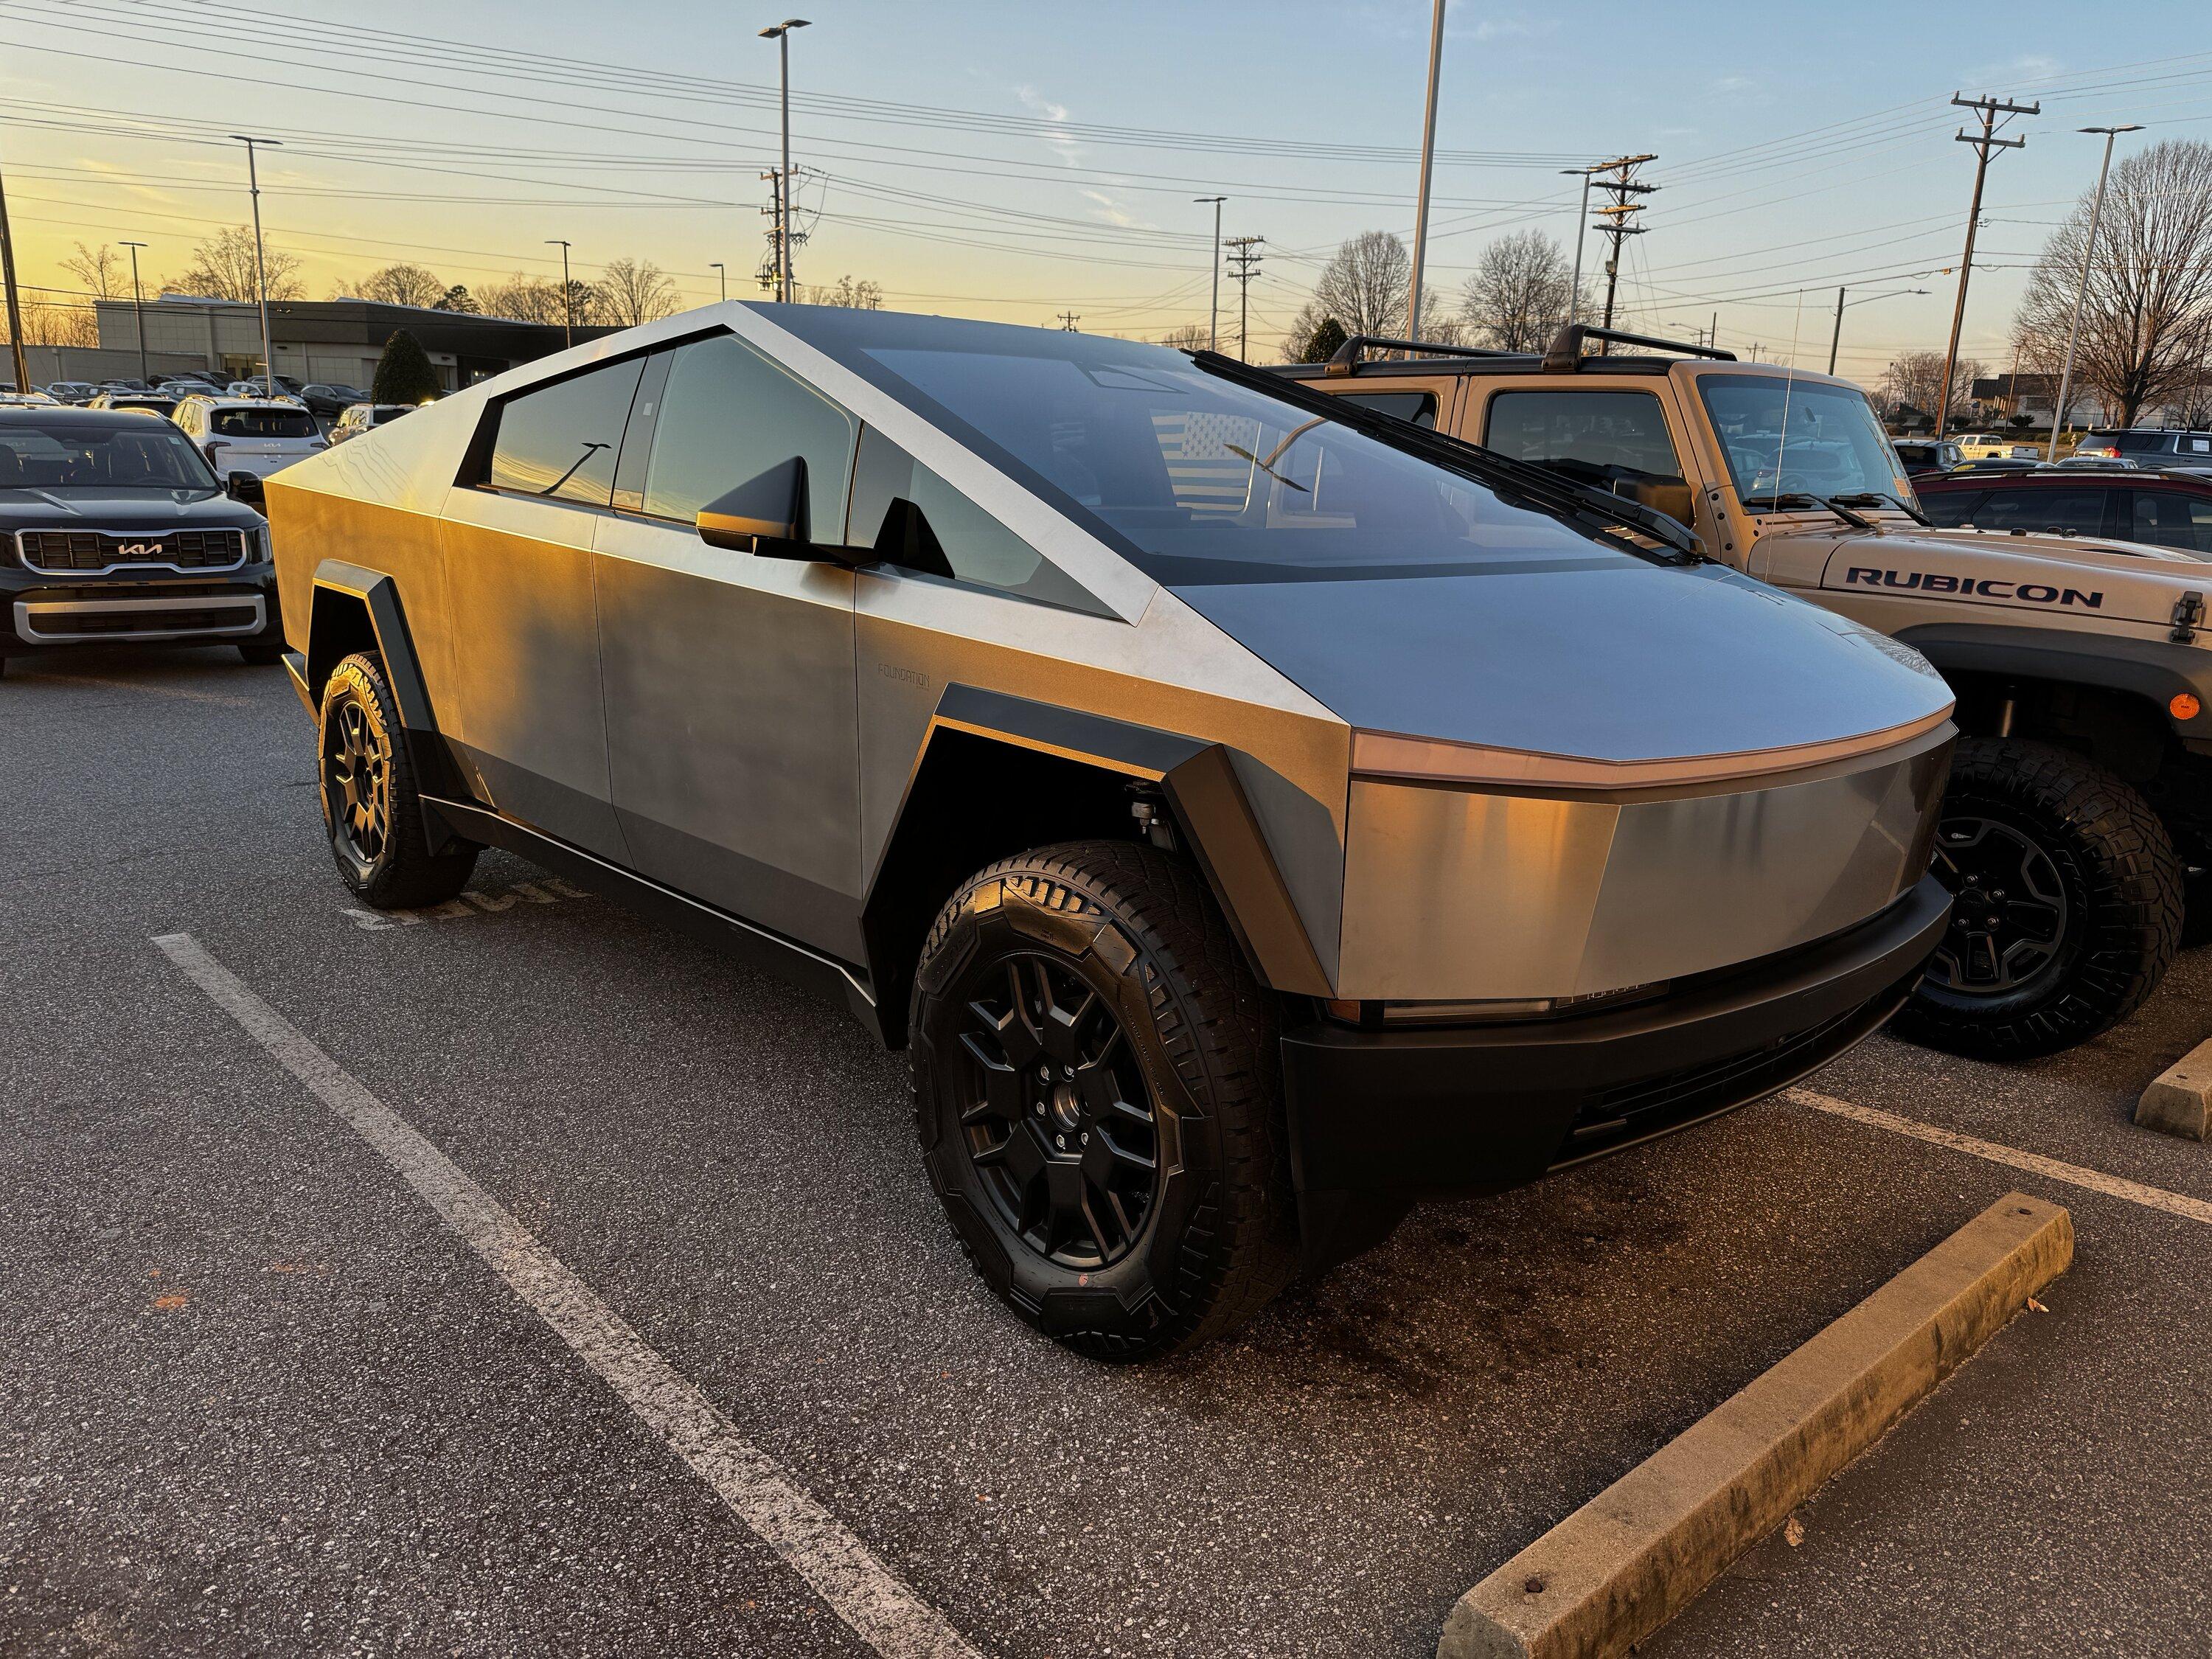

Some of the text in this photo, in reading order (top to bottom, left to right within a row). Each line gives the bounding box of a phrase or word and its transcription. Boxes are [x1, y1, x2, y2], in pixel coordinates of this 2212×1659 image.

[118, 544, 162, 554] KIA
[1845, 567, 2104, 609] RUBICON
[878, 663, 930, 688] FOUNDATION
